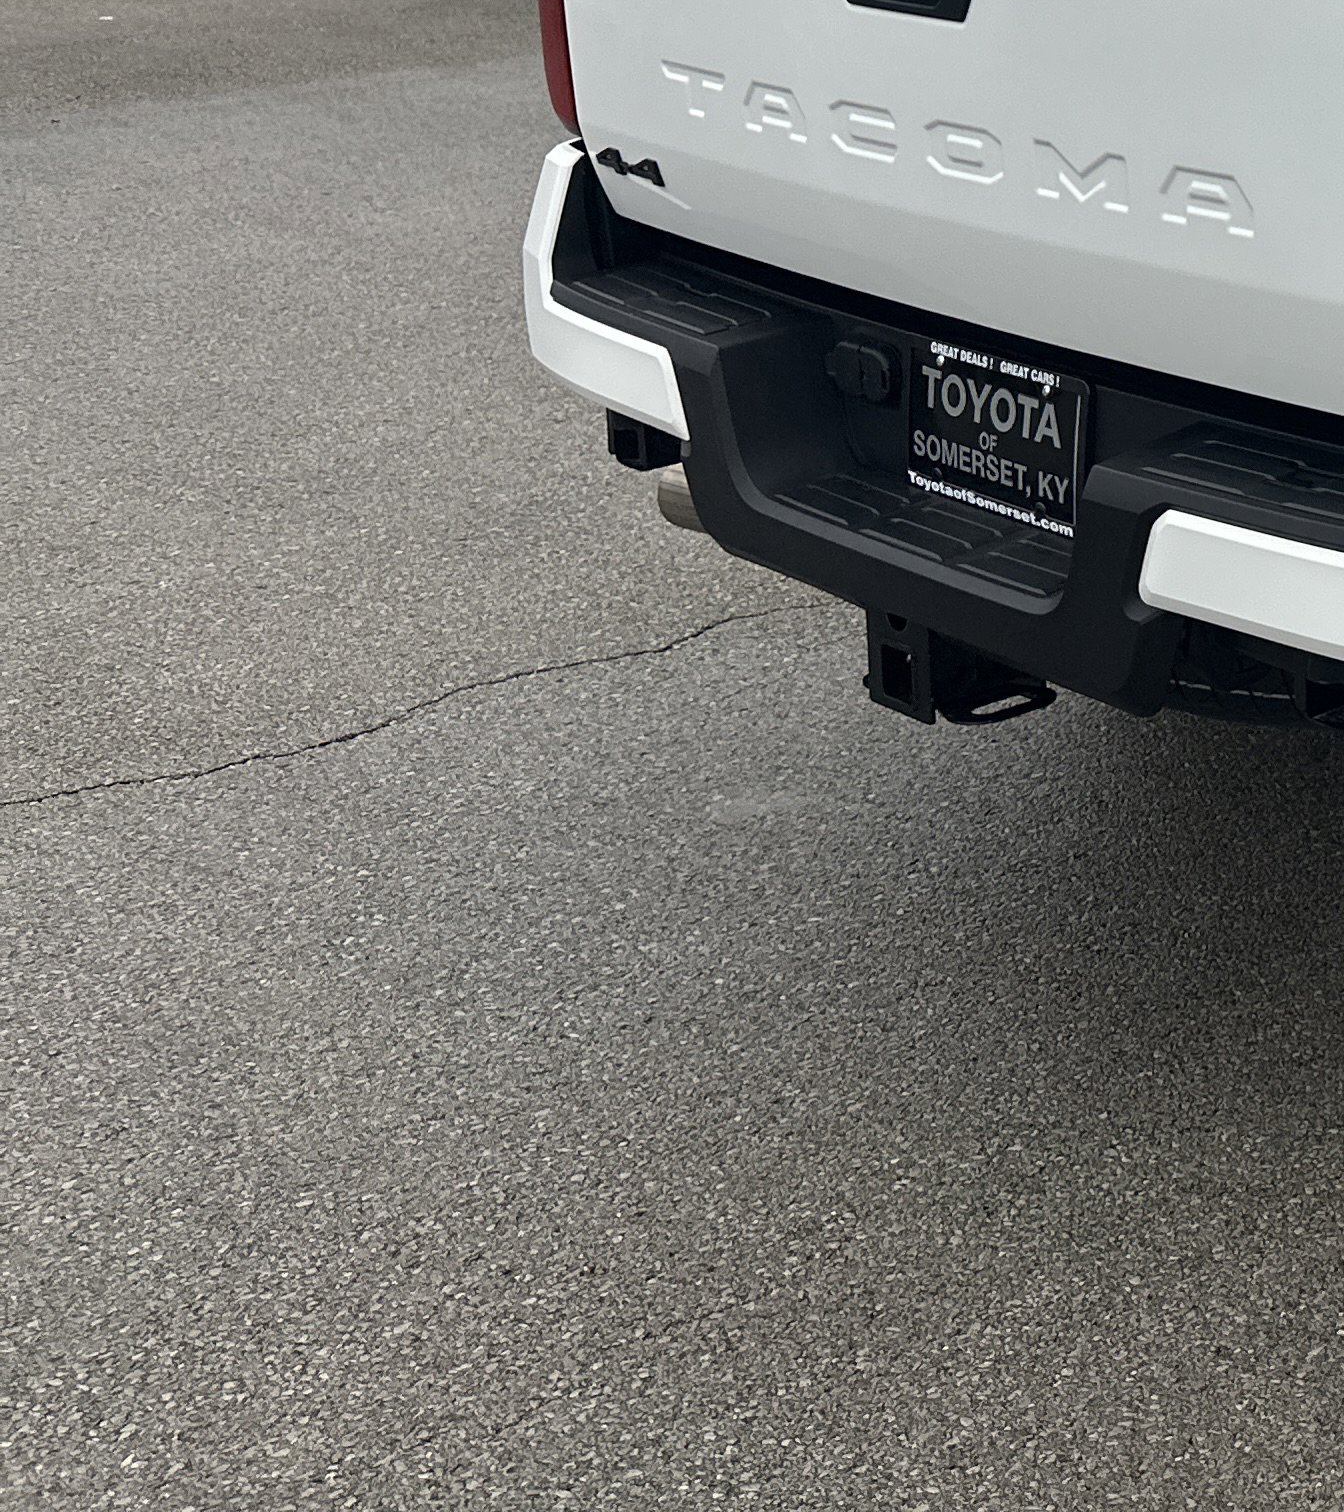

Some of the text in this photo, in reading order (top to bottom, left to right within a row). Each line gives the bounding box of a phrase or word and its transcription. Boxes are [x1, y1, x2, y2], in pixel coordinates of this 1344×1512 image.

[660, 59, 1255, 238] TACOMA
[930, 341, 960, 362] GREAT
[1000, 360, 1029, 380] GREAT
[922, 365, 1062, 449] TOYOTA
[979, 431, 998, 452] OF
[913, 429, 1069, 505] SOMERSET, KY
[907, 470, 1074, 538] ToyotaofSomerset.com
